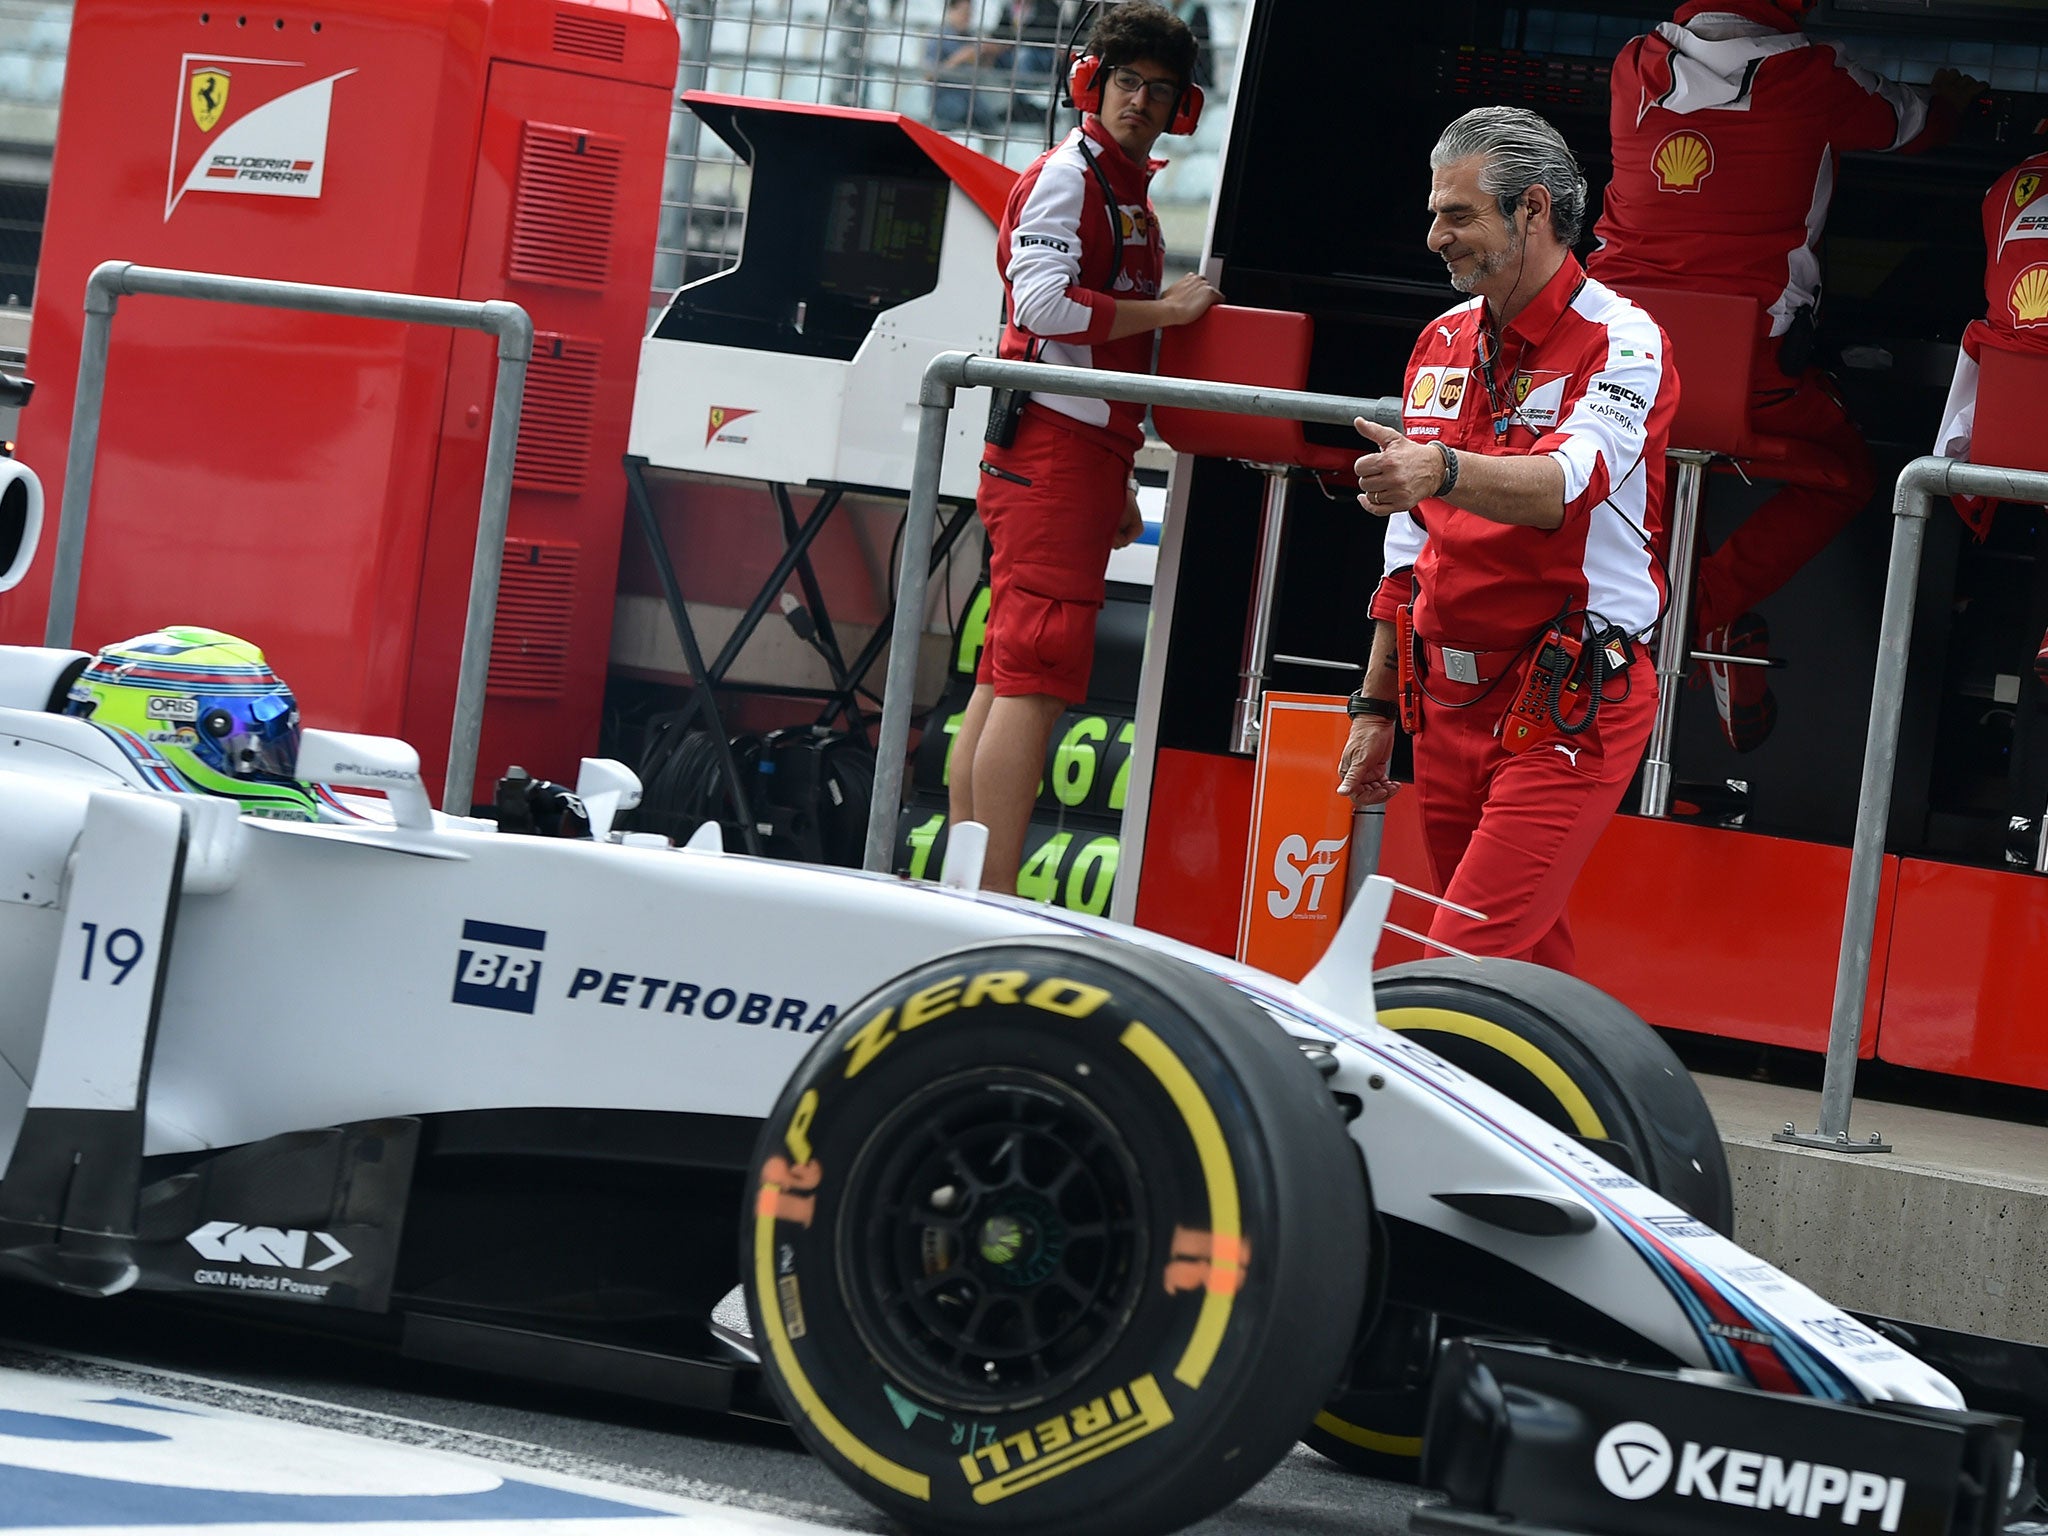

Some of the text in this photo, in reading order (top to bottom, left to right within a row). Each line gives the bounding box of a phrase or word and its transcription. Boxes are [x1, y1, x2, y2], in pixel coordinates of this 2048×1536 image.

[211, 155, 292, 169] SCUDERIA
[238, 169, 308, 184] FERRARI
[1019, 234, 1070, 254] PIRELLI
[1442, 382, 1463, 406] ups
[151, 698, 195, 713] ORIS
[81, 922, 145, 986] 19
[461, 951, 838, 1035] BR PETROBRA
[843, 970, 1112, 1079] ZERO
[194, 1269, 330, 1297] GKN Hybrid Power
[958, 1372, 1175, 1506] PIRELLI
[1674, 1441, 1906, 1533] KEMPPI
